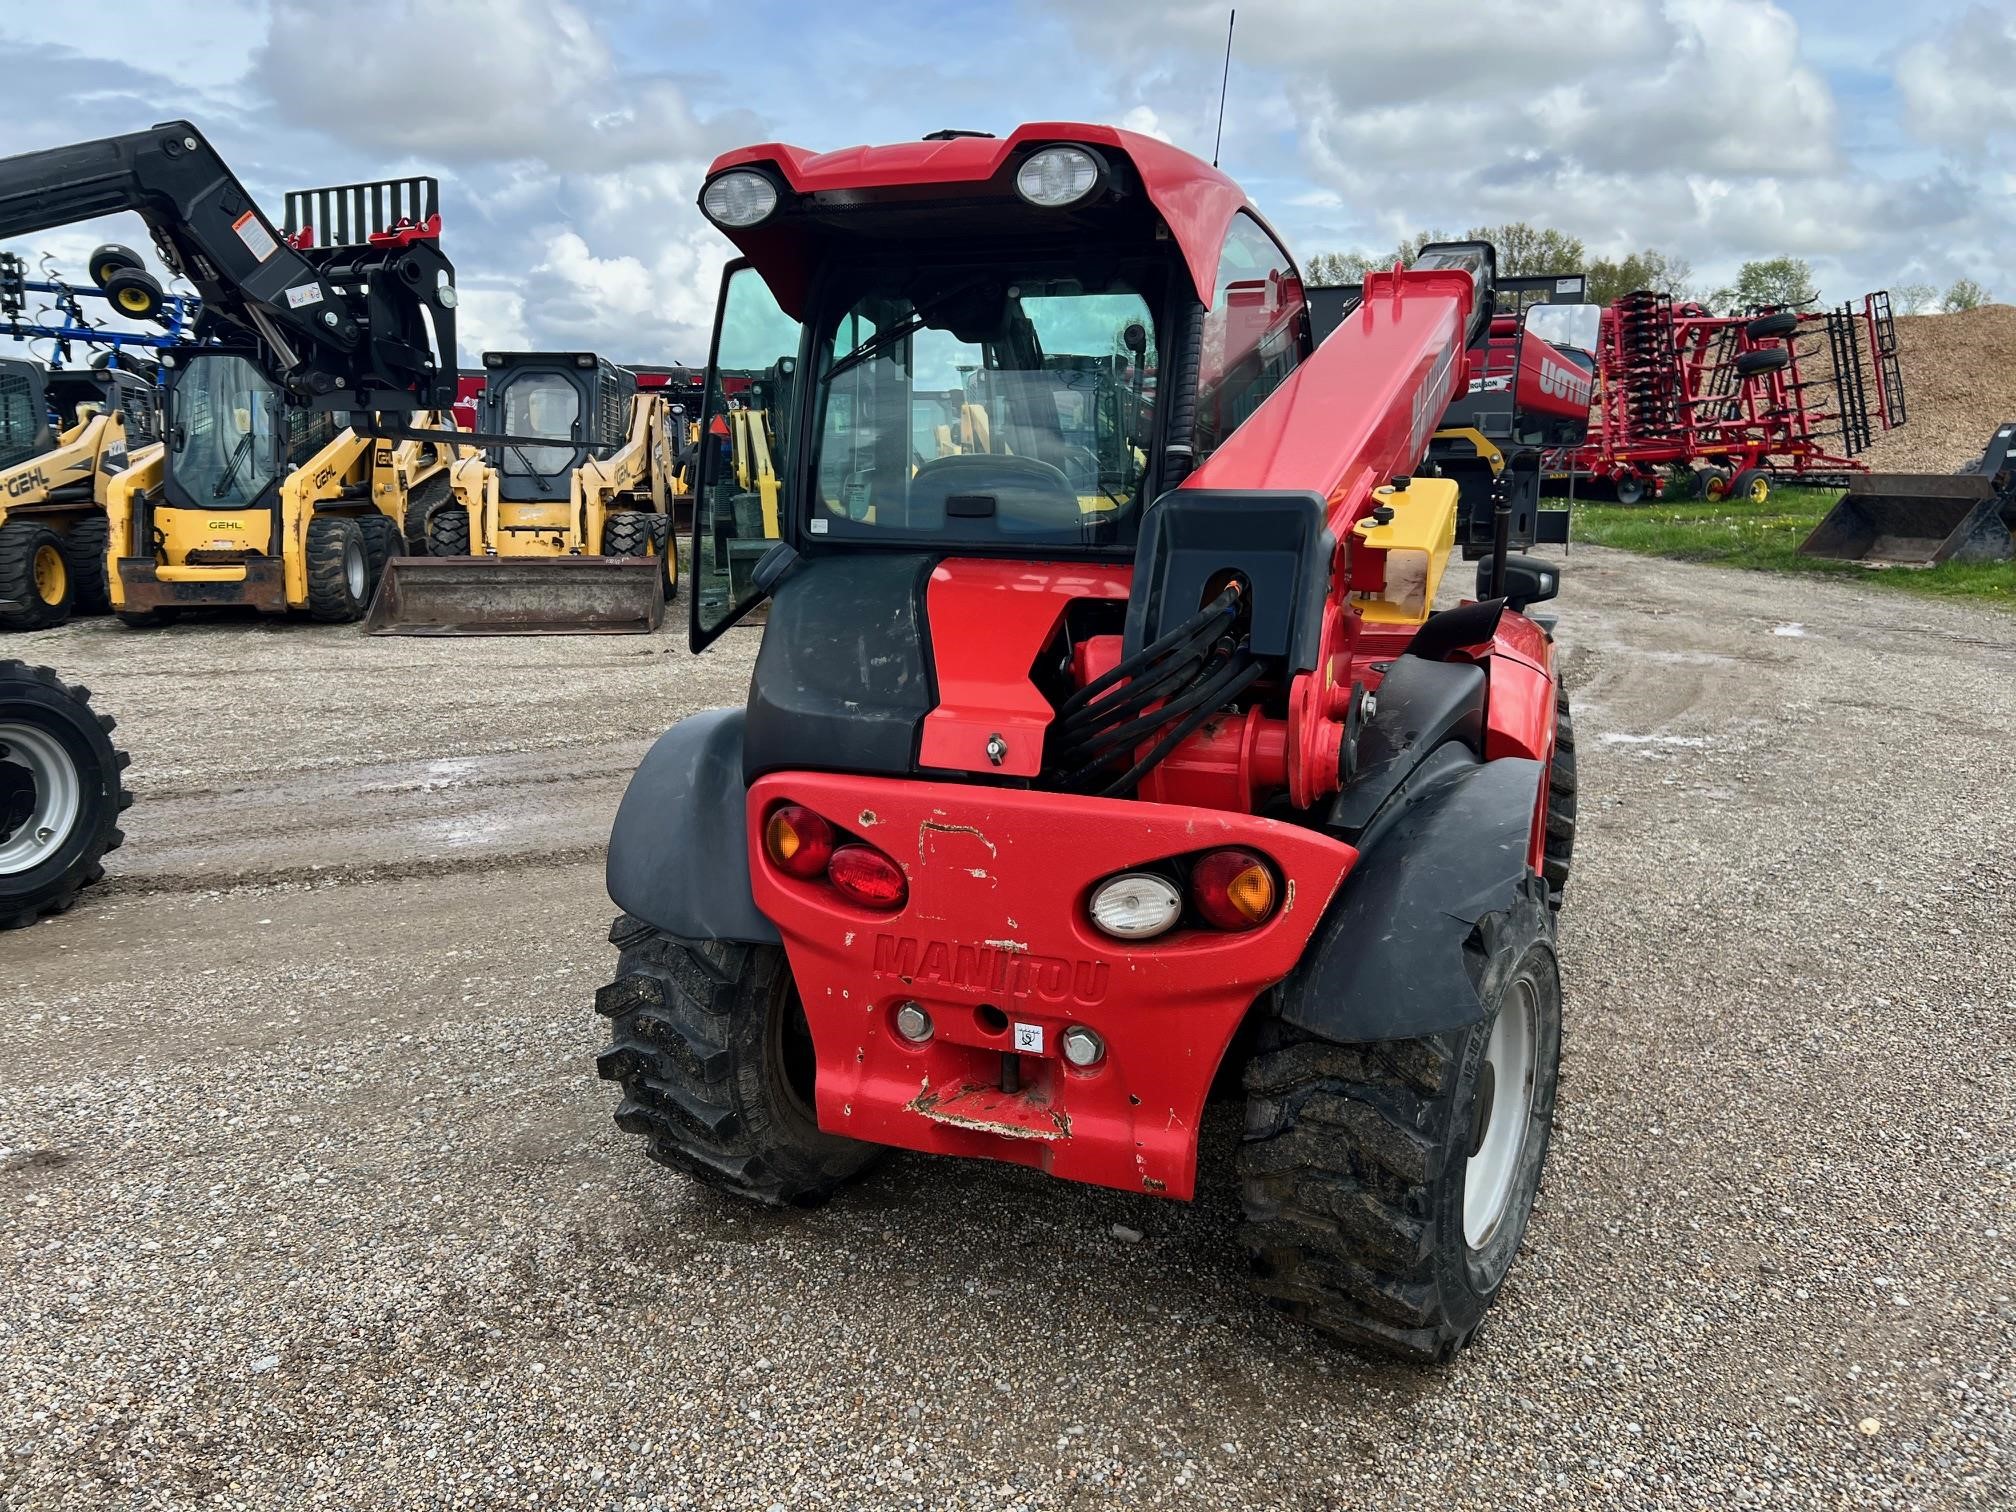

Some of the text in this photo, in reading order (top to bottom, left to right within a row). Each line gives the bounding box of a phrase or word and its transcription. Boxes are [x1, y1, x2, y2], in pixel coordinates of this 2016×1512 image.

[7, 466, 50, 498] GEHL
[314, 464, 337, 490] GEHL
[209, 521, 243, 530] GEHL
[873, 933, 1111, 1006] MANITOU
